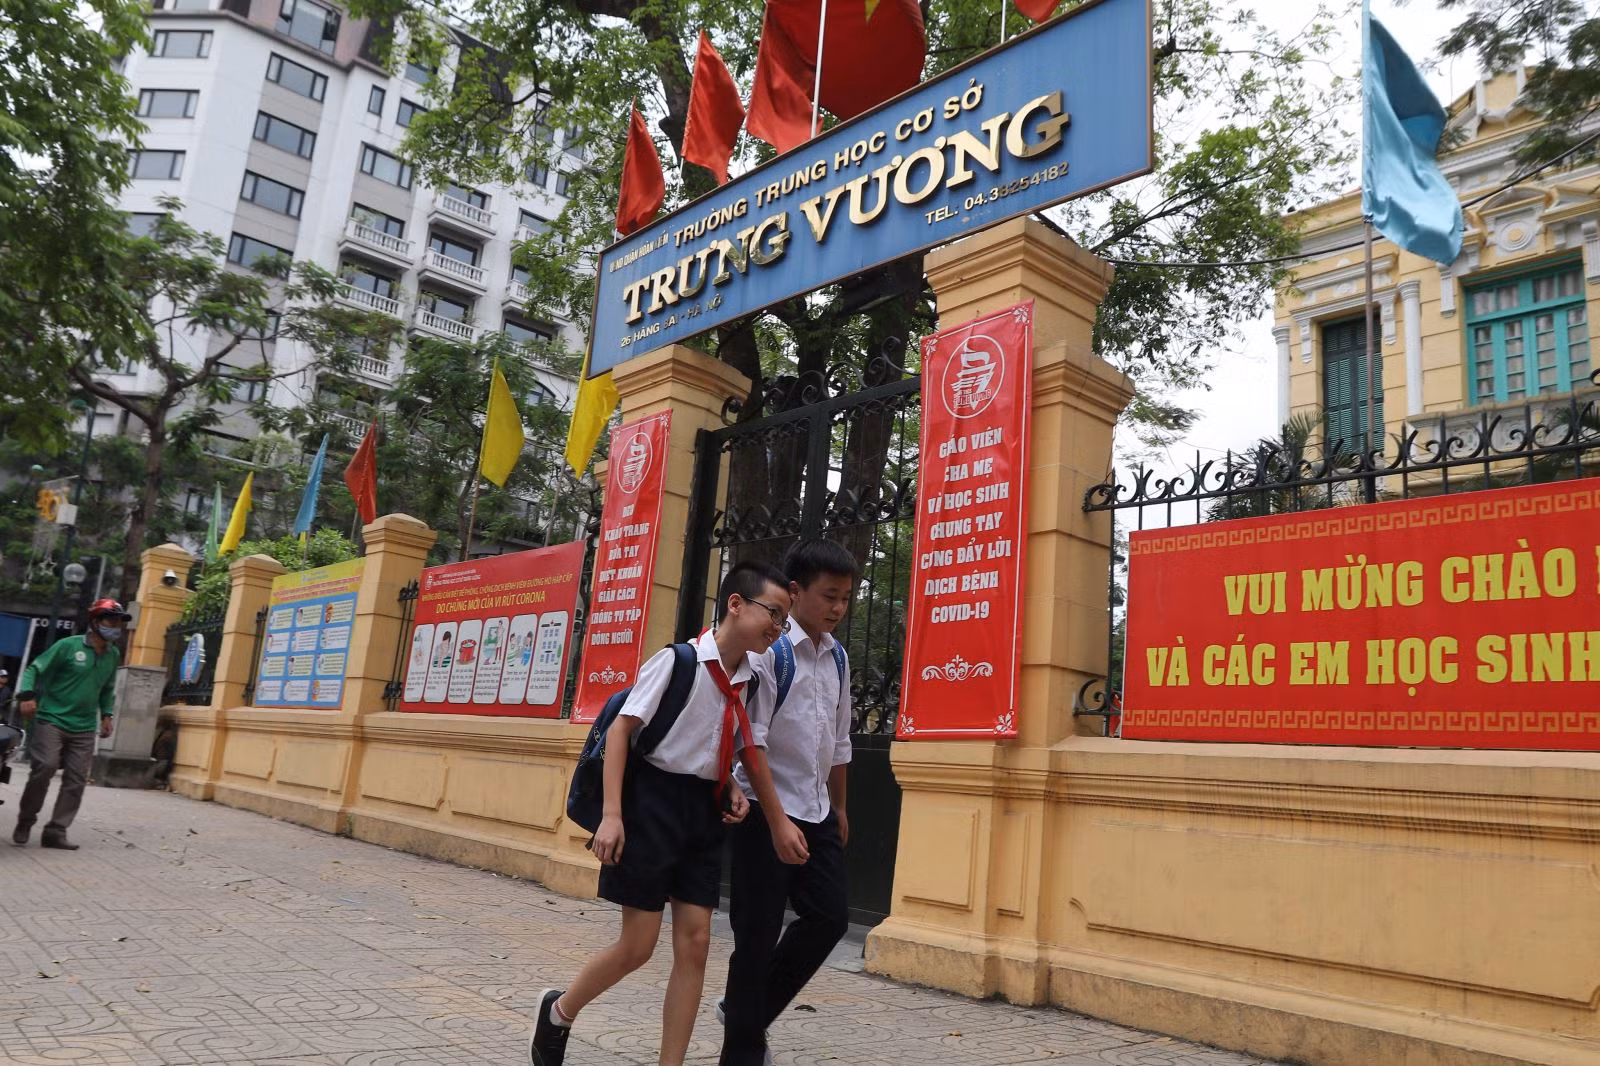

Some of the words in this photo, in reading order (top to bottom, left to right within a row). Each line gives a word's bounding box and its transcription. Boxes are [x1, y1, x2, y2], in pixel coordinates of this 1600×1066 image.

[674, 198, 747, 247] TRƯỜNG
[755, 159, 828, 208] TRUNG
[834, 131, 886, 171] HỌC
[895, 107, 934, 141] CƠ
[943, 77, 984, 119] SỞ
[623, 211, 791, 325] TRƯNG
[800, 91, 1071, 244] VƯƠNG
[634, 322, 660, 342] HÀNG
[971, 426, 1002, 450] VIÊN
[973, 457, 993, 478] MẸ
[944, 489, 972, 513] HỌC
[976, 481, 1009, 504] SINH
[623, 522, 650, 537] TRANG
[976, 511, 1003, 532] TAY
[623, 544, 640, 559] TAY
[957, 537, 984, 564] ĐẨY
[987, 535, 1011, 559] LÙI
[617, 560, 643, 580] KHUẨN
[1224, 571, 1287, 616] VUI
[1300, 553, 1424, 613] MỪNG
[1440, 538, 1577, 603] CHÀO
[617, 585, 637, 601] CÁCH
[924, 576, 958, 599] DỊCH
[961, 569, 998, 595] BỆNH
[516, 590, 545, 605] CORONA
[614, 610, 625, 625] TỤ
[626, 605, 642, 624] TẬP
[931, 601, 990, 624] COVID-19
[1146, 635, 1190, 687] VÀ
[1202, 633, 1276, 686] CÁC
[1289, 640, 1350, 686] EM
[1365, 635, 1459, 697] HỌC
[1475, 630, 1600, 684] SINH
